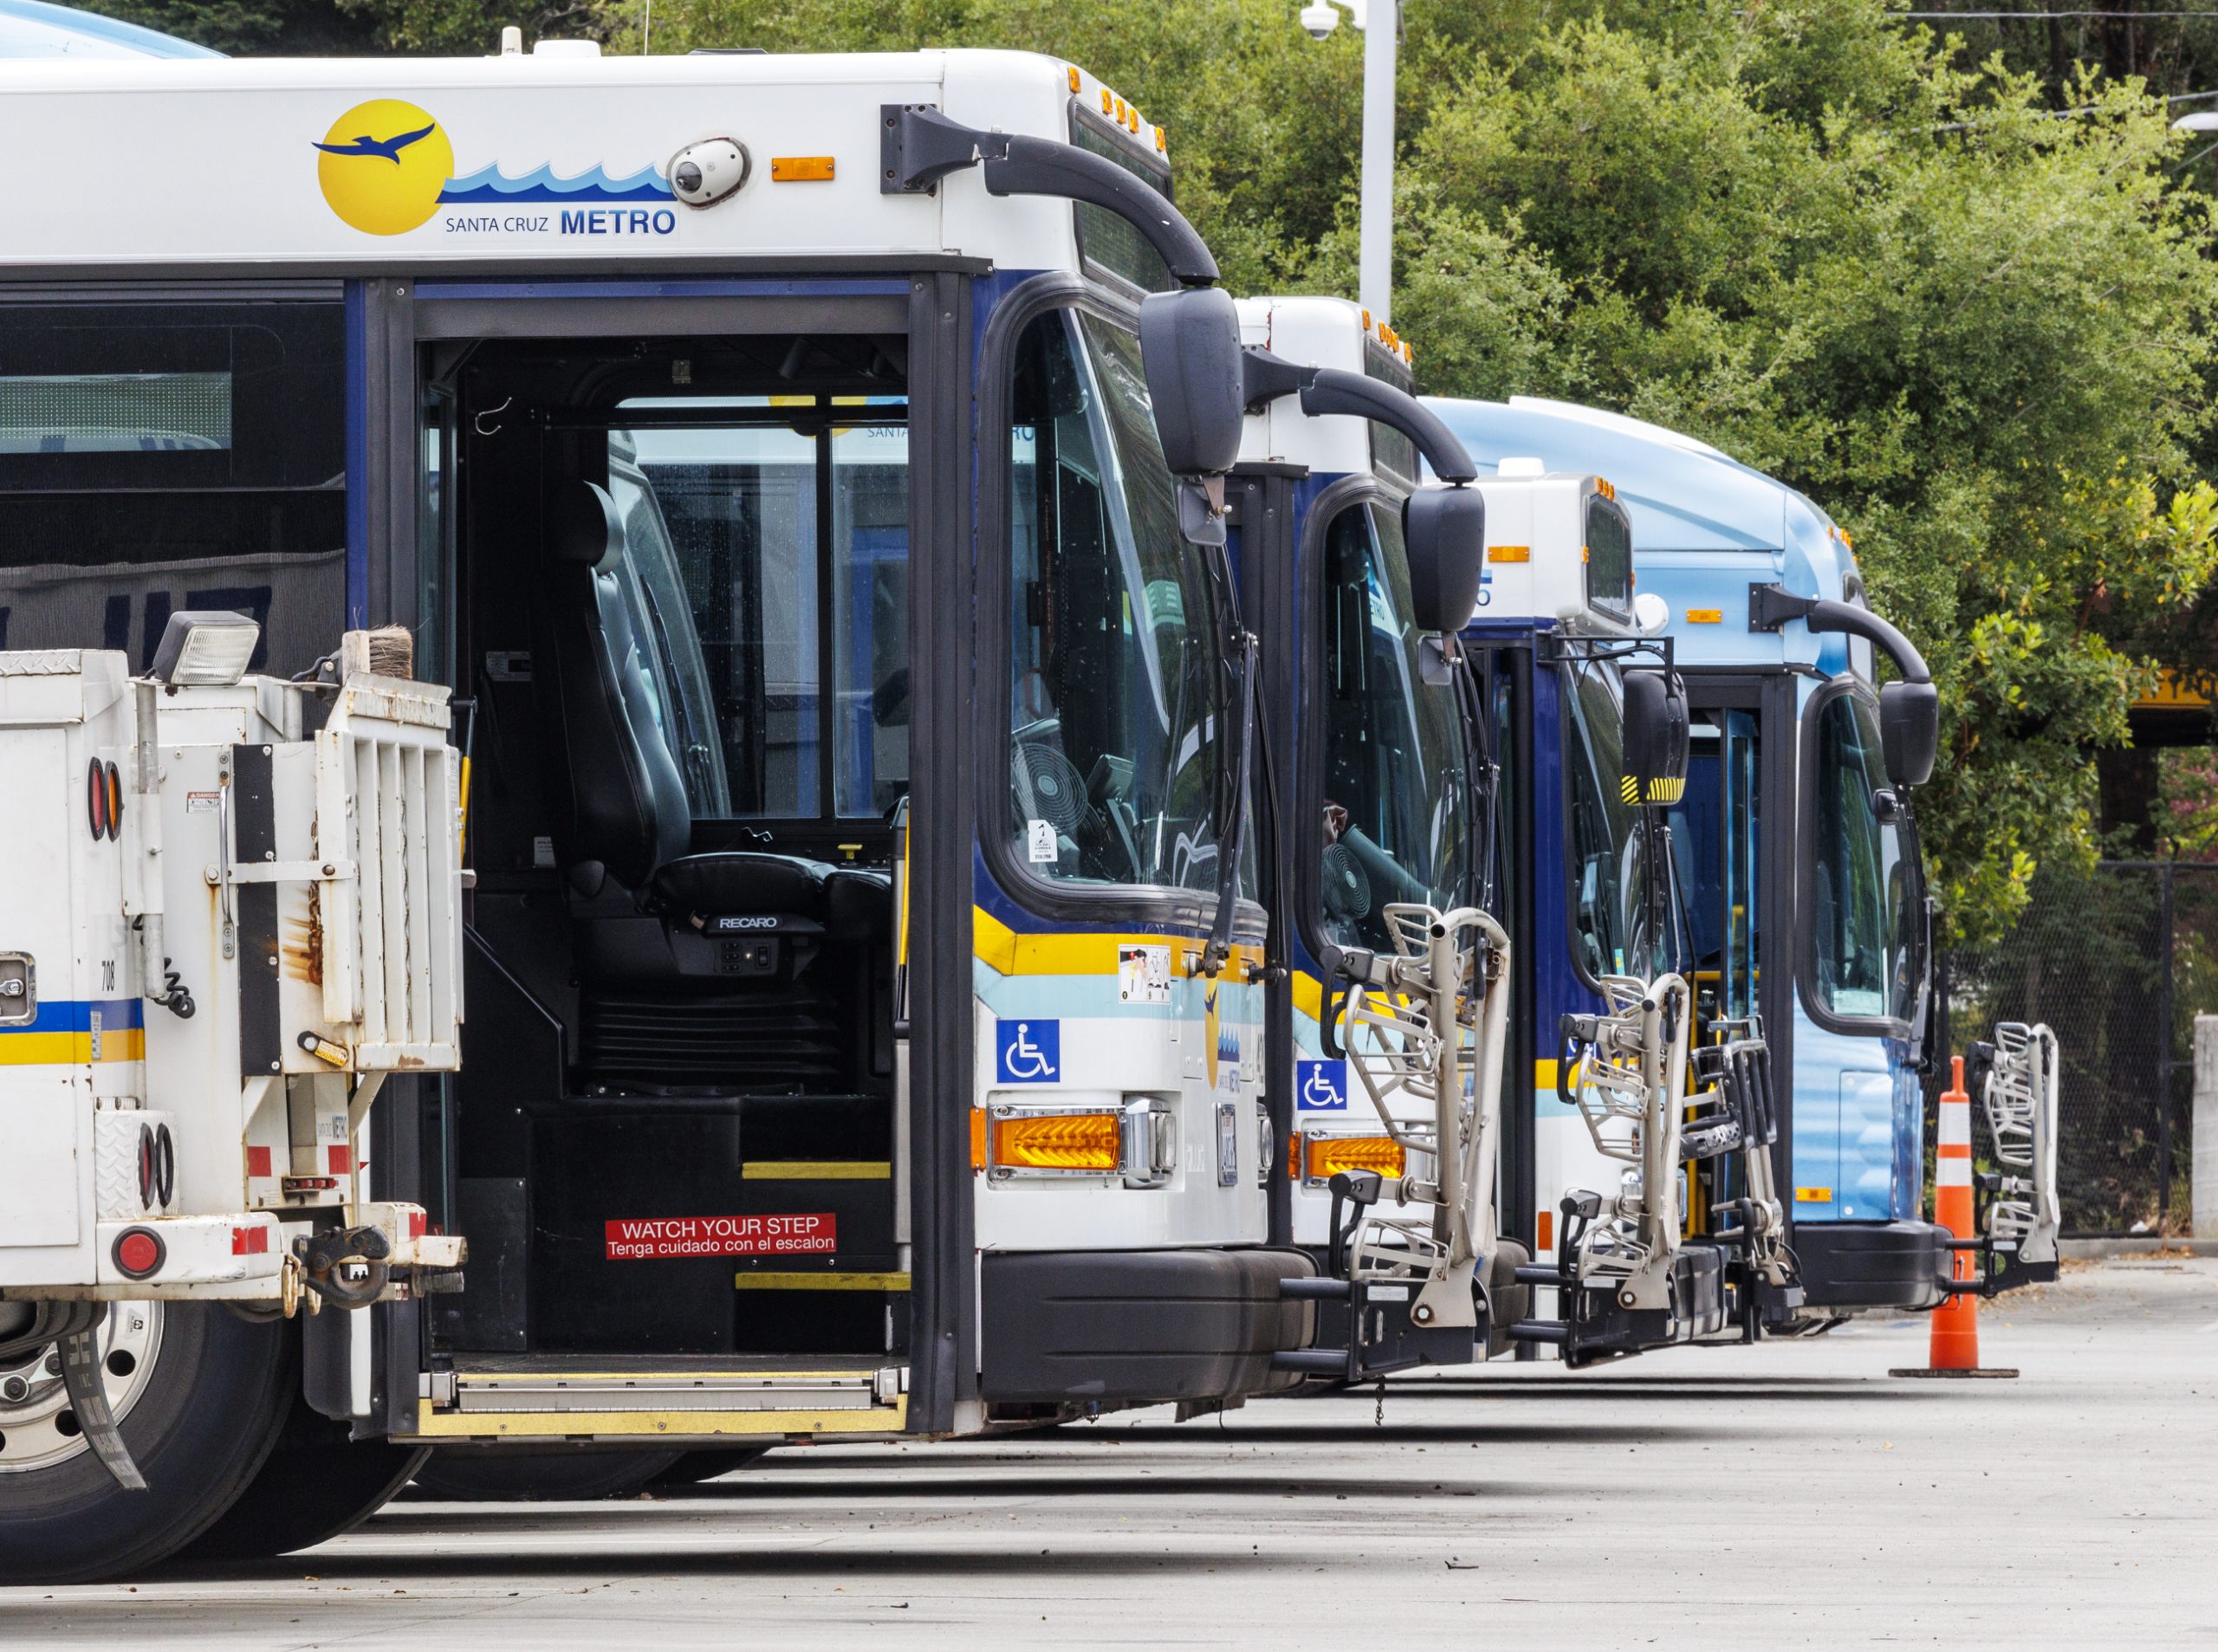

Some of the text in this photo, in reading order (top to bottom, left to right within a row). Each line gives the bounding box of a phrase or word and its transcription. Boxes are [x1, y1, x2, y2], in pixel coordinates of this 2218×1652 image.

[445, 210, 677, 235] SANTA CRUZ METRO
[719, 917, 777, 929] RECARO
[101, 960, 115, 991] 708
[622, 1217, 820, 1239] WATCH YOUR STEP
[608, 1235, 834, 1259] Tenga cuidado con el escalon
